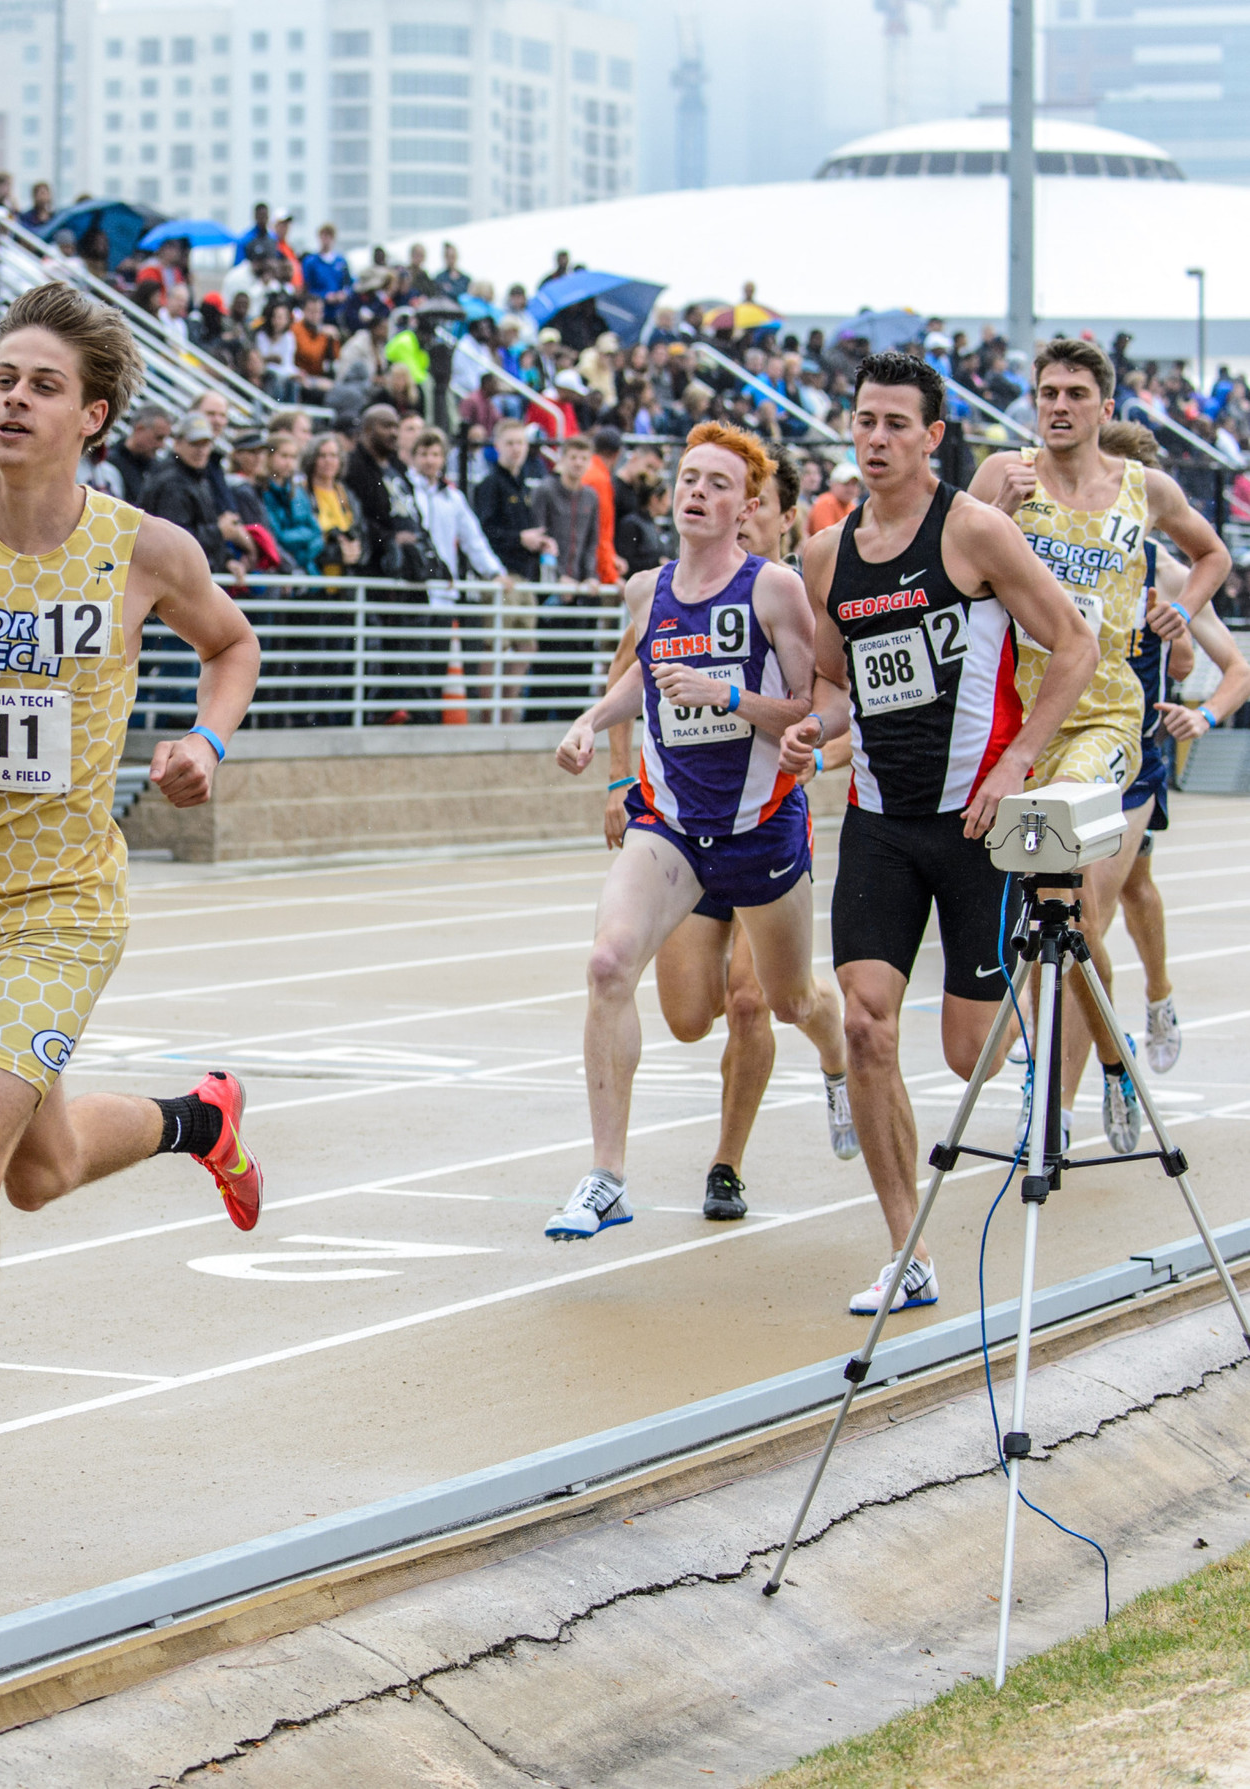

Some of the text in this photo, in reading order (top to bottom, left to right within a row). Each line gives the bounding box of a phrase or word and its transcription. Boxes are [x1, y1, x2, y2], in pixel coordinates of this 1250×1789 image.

[1110, 515, 1141, 553] 14
[838, 588, 930, 621] GEORGIA
[1074, 596, 1095, 607] TECH
[44, 604, 102, 655] 12
[657, 618, 679, 630] ACC
[716, 607, 745, 653] 9
[932, 611, 968, 660] 2
[651, 633, 712, 661] CLEMS
[858, 634, 912, 652] GEORGIA TECH
[865, 649, 915, 689] 398
[20, 695, 53, 708] TECH
[867, 689, 923, 707] TRACK & FIELD
[673, 723, 737, 738] TRACK & FIELD
[1, 770, 11, 781] &
[16, 770, 51, 783] FIELD
